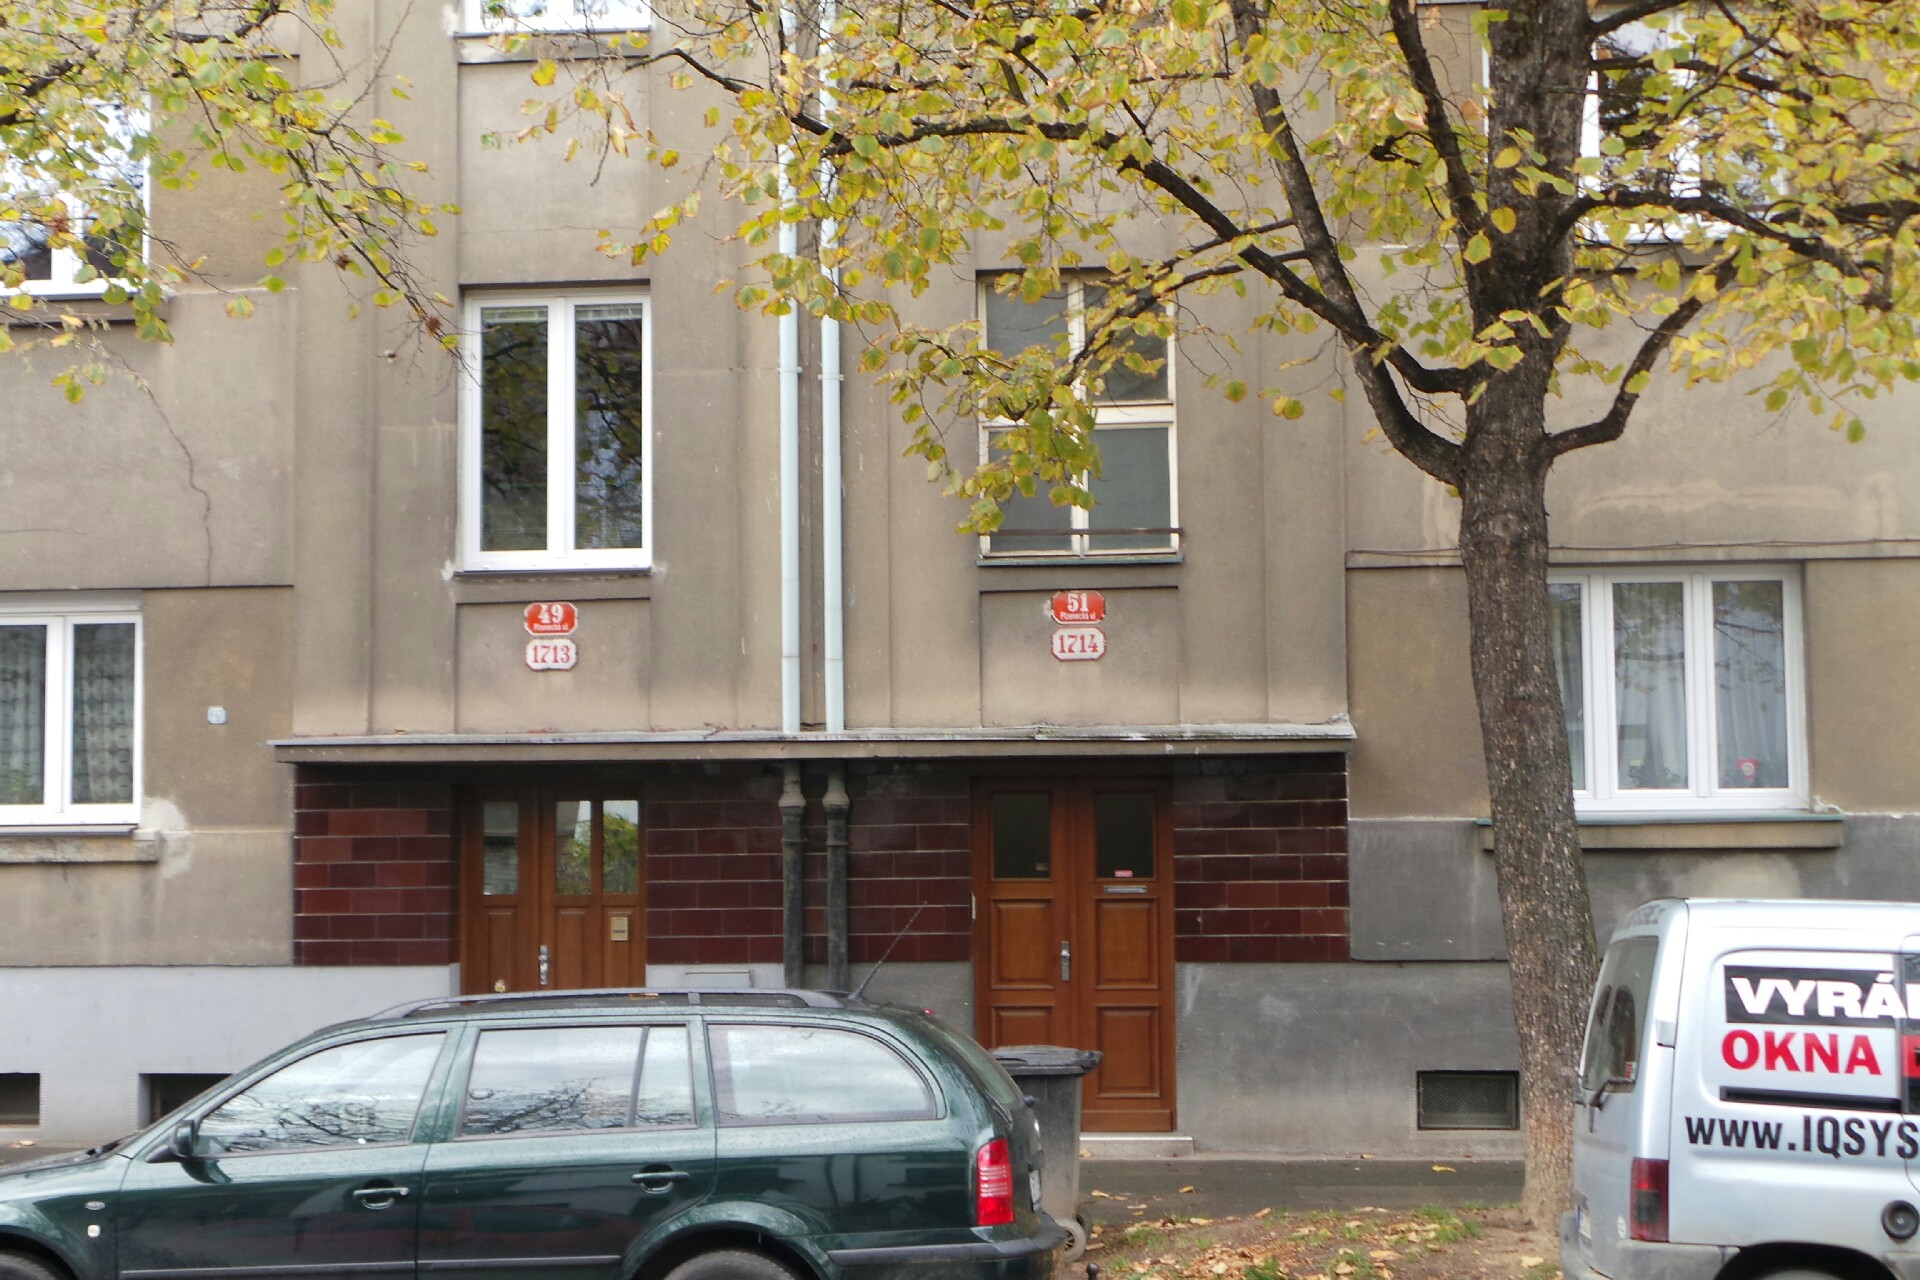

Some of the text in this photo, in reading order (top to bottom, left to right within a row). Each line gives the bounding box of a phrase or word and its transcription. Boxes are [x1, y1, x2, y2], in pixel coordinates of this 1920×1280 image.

[1067, 592, 1089, 612] 51
[538, 604, 563, 624] 49
[1059, 634, 1099, 653] 1714
[532, 645, 570, 663] 1713
[1721, 1029, 1883, 1076] OKNA
[1684, 1115, 1920, 1159] WWW.IQSYS
